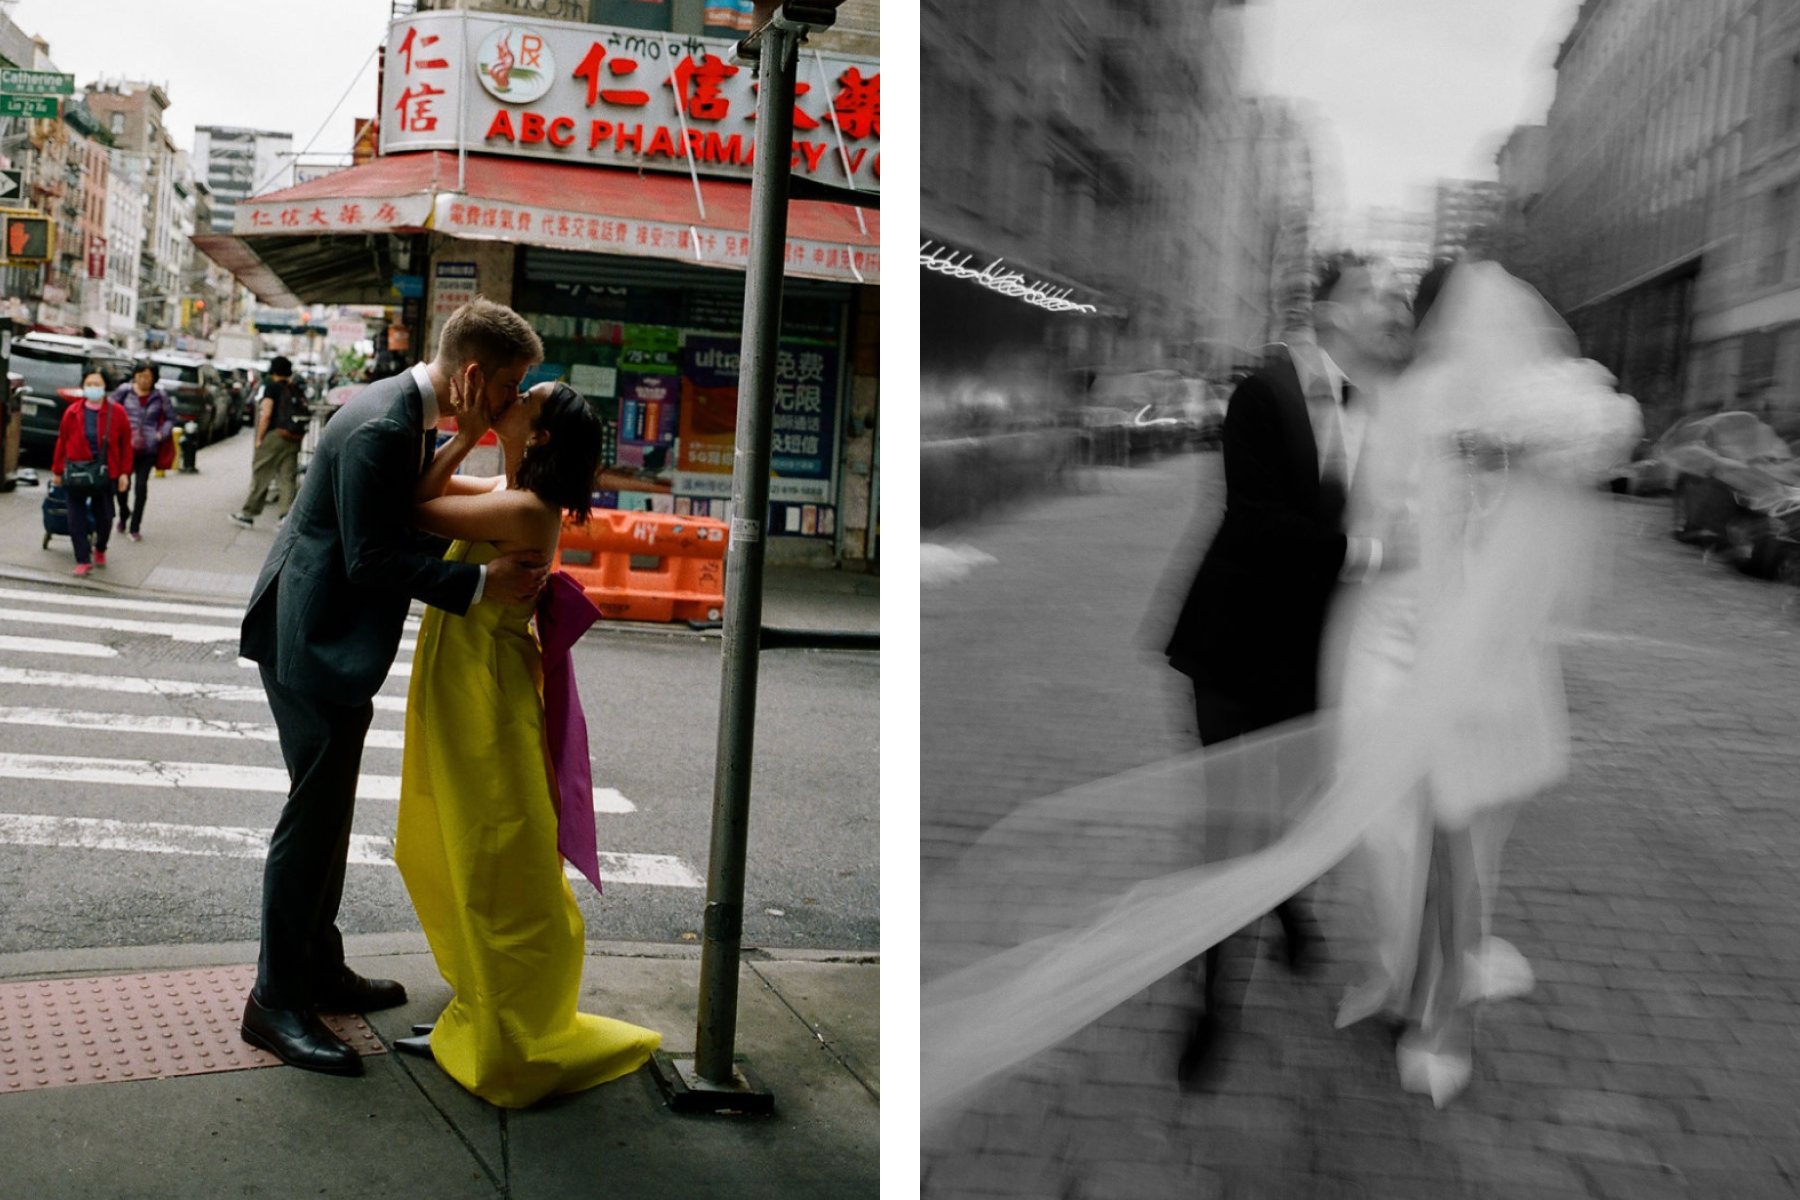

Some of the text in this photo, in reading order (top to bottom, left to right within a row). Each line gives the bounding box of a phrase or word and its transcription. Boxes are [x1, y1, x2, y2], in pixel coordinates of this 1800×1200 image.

[2, 71, 63, 87] Catherine
[395, 27, 449, 132] 仁信
[486, 109, 576, 147] ABC
[588, 119, 826, 173] PHARMY
[694, 348, 740, 370] ultra
